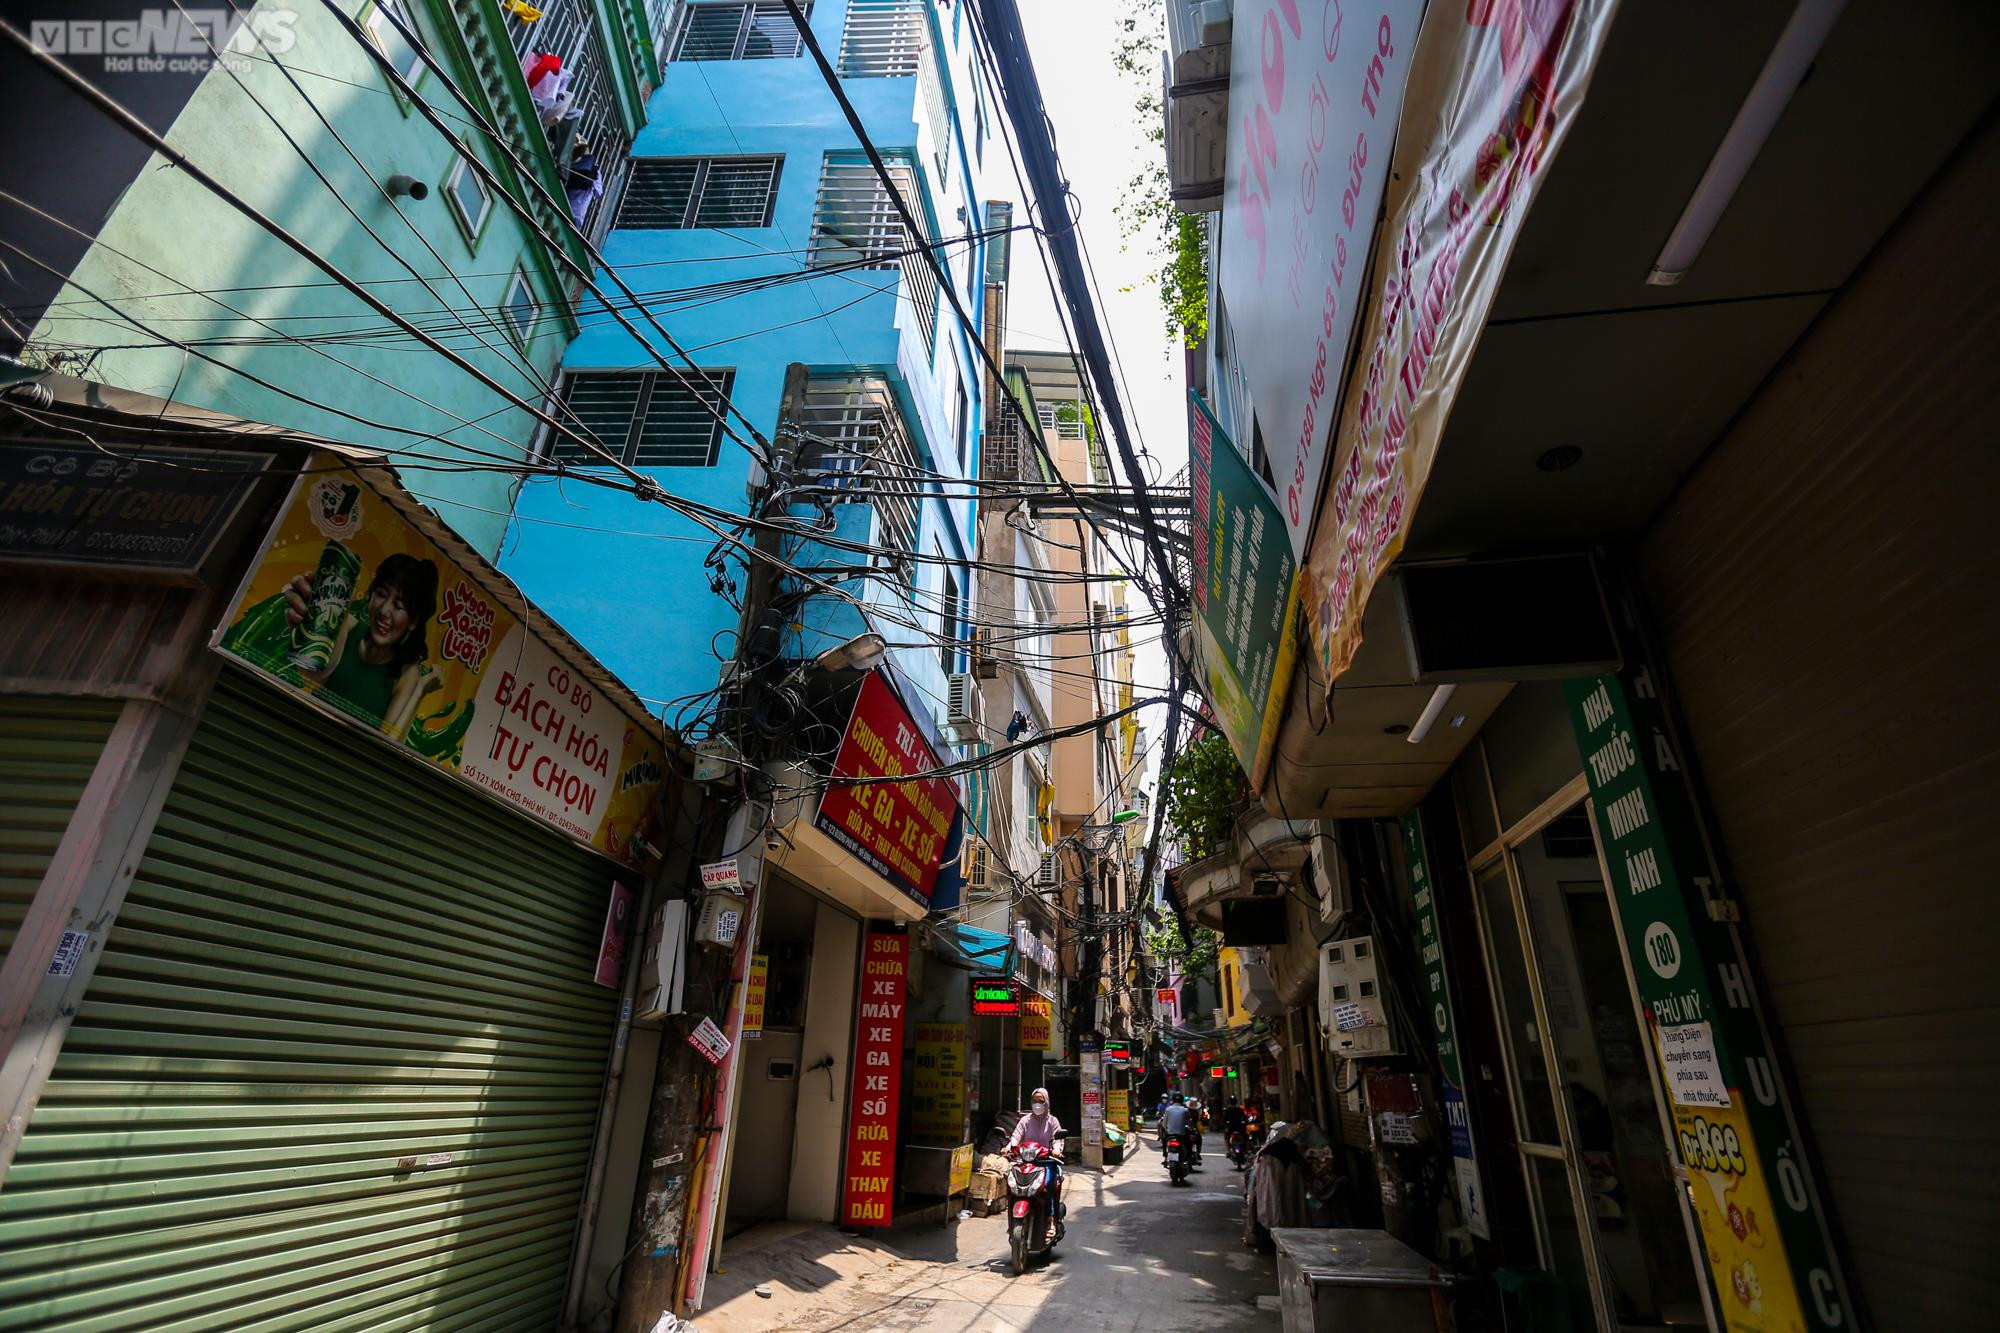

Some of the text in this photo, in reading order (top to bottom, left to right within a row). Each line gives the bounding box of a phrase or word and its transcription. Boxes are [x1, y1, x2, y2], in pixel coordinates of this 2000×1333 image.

[1322, 287, 1337, 338] 63
[1331, 233, 1347, 289] Lê
[1341, 132, 1369, 232] Đức
[1362, 14, 1396, 120] Thọ
[1193, 457, 1210, 529] MINH
[1216, 488, 1226, 528] GPP
[547, 666, 592, 718] CÔ BỘ
[1581, 678, 1614, 733] NHÀ
[494, 671, 609, 778] BÁCH HÓA
[851, 716, 888, 769] CHUYÊN
[1589, 724, 1636, 788] THUỐC
[493, 726, 596, 816] TỰ CHỌN
[464, 765, 476, 777] SỐ
[476, 771, 489, 785] 121
[489, 778, 506, 794] XÓM
[522, 795, 536, 810] PHÚ
[549, 811, 559, 823] ĐT:
[1606, 786, 1650, 840] MINH
[845, 808, 865, 835] RỬA
[861, 822, 873, 842] XE
[873, 788, 896, 829] GA
[900, 815, 920, 852] XE
[917, 833, 936, 865] SỐ
[703, 869, 737, 882] CÁP QUANG
[1625, 847, 1662, 896] ÁNH
[873, 936, 900, 954] SỬA
[1650, 932, 1676, 968] 180
[866, 960, 903, 976] CHỮA
[872, 981, 895, 995] XE
[862, 1002, 901, 1018] MÁY
[1653, 988, 1703, 1024] PHÚ MỸ
[868, 1027, 892, 1042] XE
[1023, 1021, 1049, 1041] HỒNG
[866, 1052, 890, 1066] GA
[1692, 1050, 1711, 1062] sang
[865, 1075, 888, 1091] XE
[1694, 1071, 1709, 1081] sau
[862, 1096, 888, 1116] SỐ
[1683, 1089, 1697, 1102] nhà
[857, 1121, 889, 1141] RỬA
[860, 1151, 881, 1167] XE
[851, 1177, 889, 1193] THAY
[851, 1197, 885, 1220] DẦU
